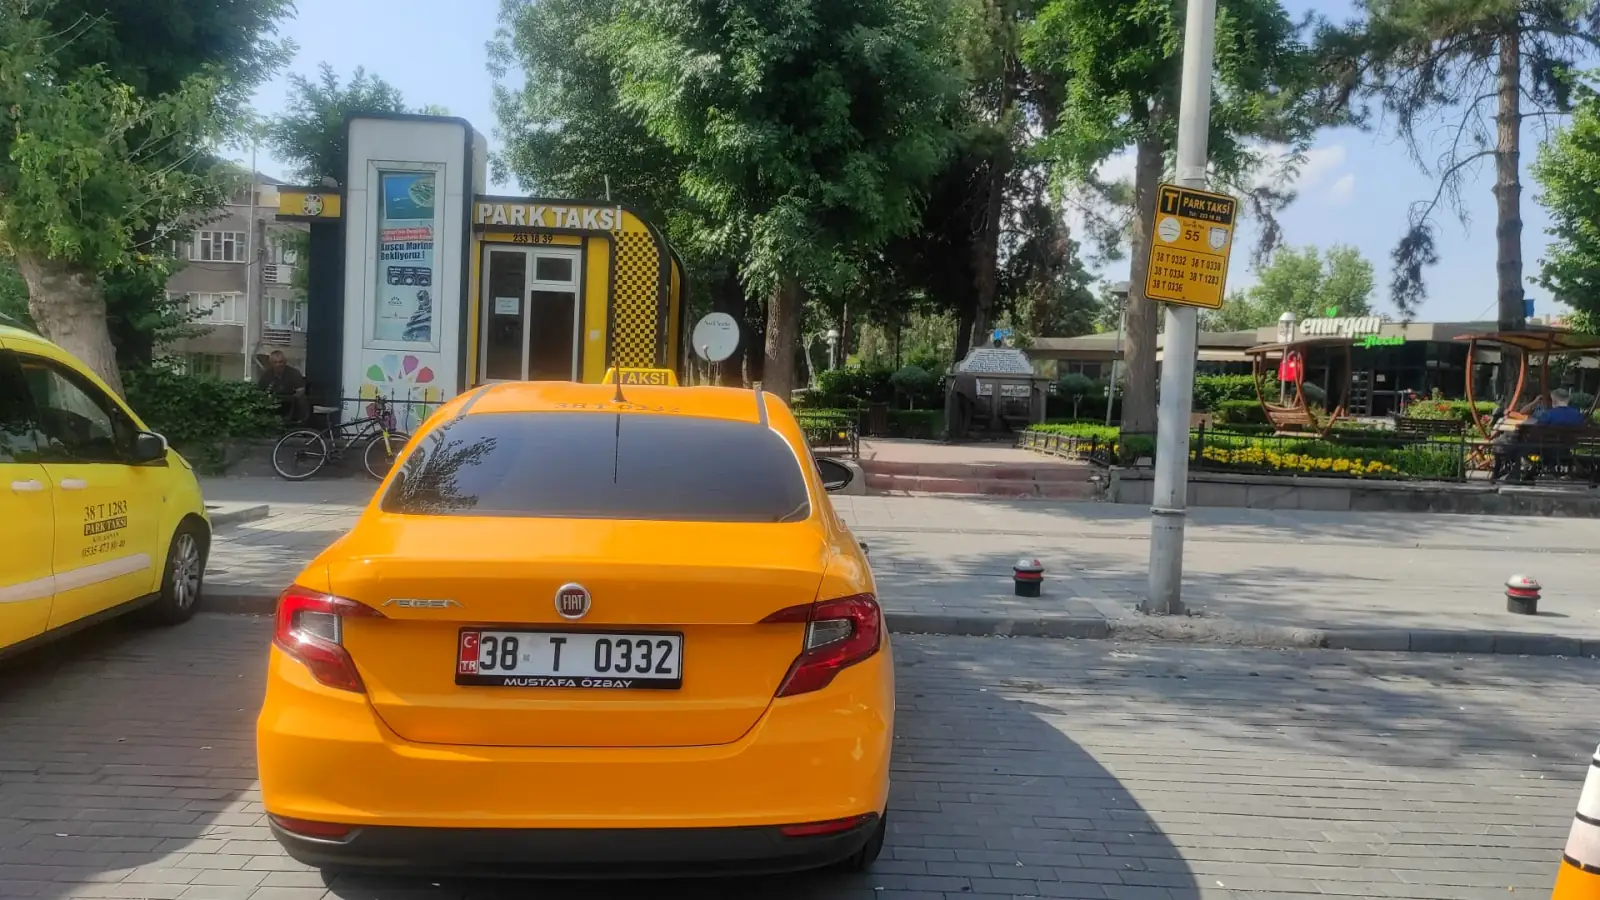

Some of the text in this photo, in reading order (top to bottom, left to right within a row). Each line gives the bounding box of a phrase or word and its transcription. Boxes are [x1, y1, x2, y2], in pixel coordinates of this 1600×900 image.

[1183, 197, 1205, 210] PARK
[478, 203, 622, 230] PARK TAKSİ
[512, 234, 553, 243] 233 18 39
[1185, 230, 1200, 242] 55
[1156, 252, 1186, 265] 38 T 0332
[1191, 258, 1199, 268] 38
[1201, 260, 1205, 268] T
[1154, 266, 1184, 279] 38 T 0334
[1189, 272, 1219, 285] 38 T 1283
[1152, 279, 1160, 288] 38
[1162, 281, 1166, 290] T
[1299, 317, 1381, 339] emirgan
[84, 500, 127, 521] 38 T 1283
[85, 522, 106, 534] PARK
[562, 594, 585, 611] FIAT
[480, 636, 672, 674] 38 T 0332
[461, 660, 478, 671] TR
[503, 677, 632, 689] MUSTAFA ÖZBAY
